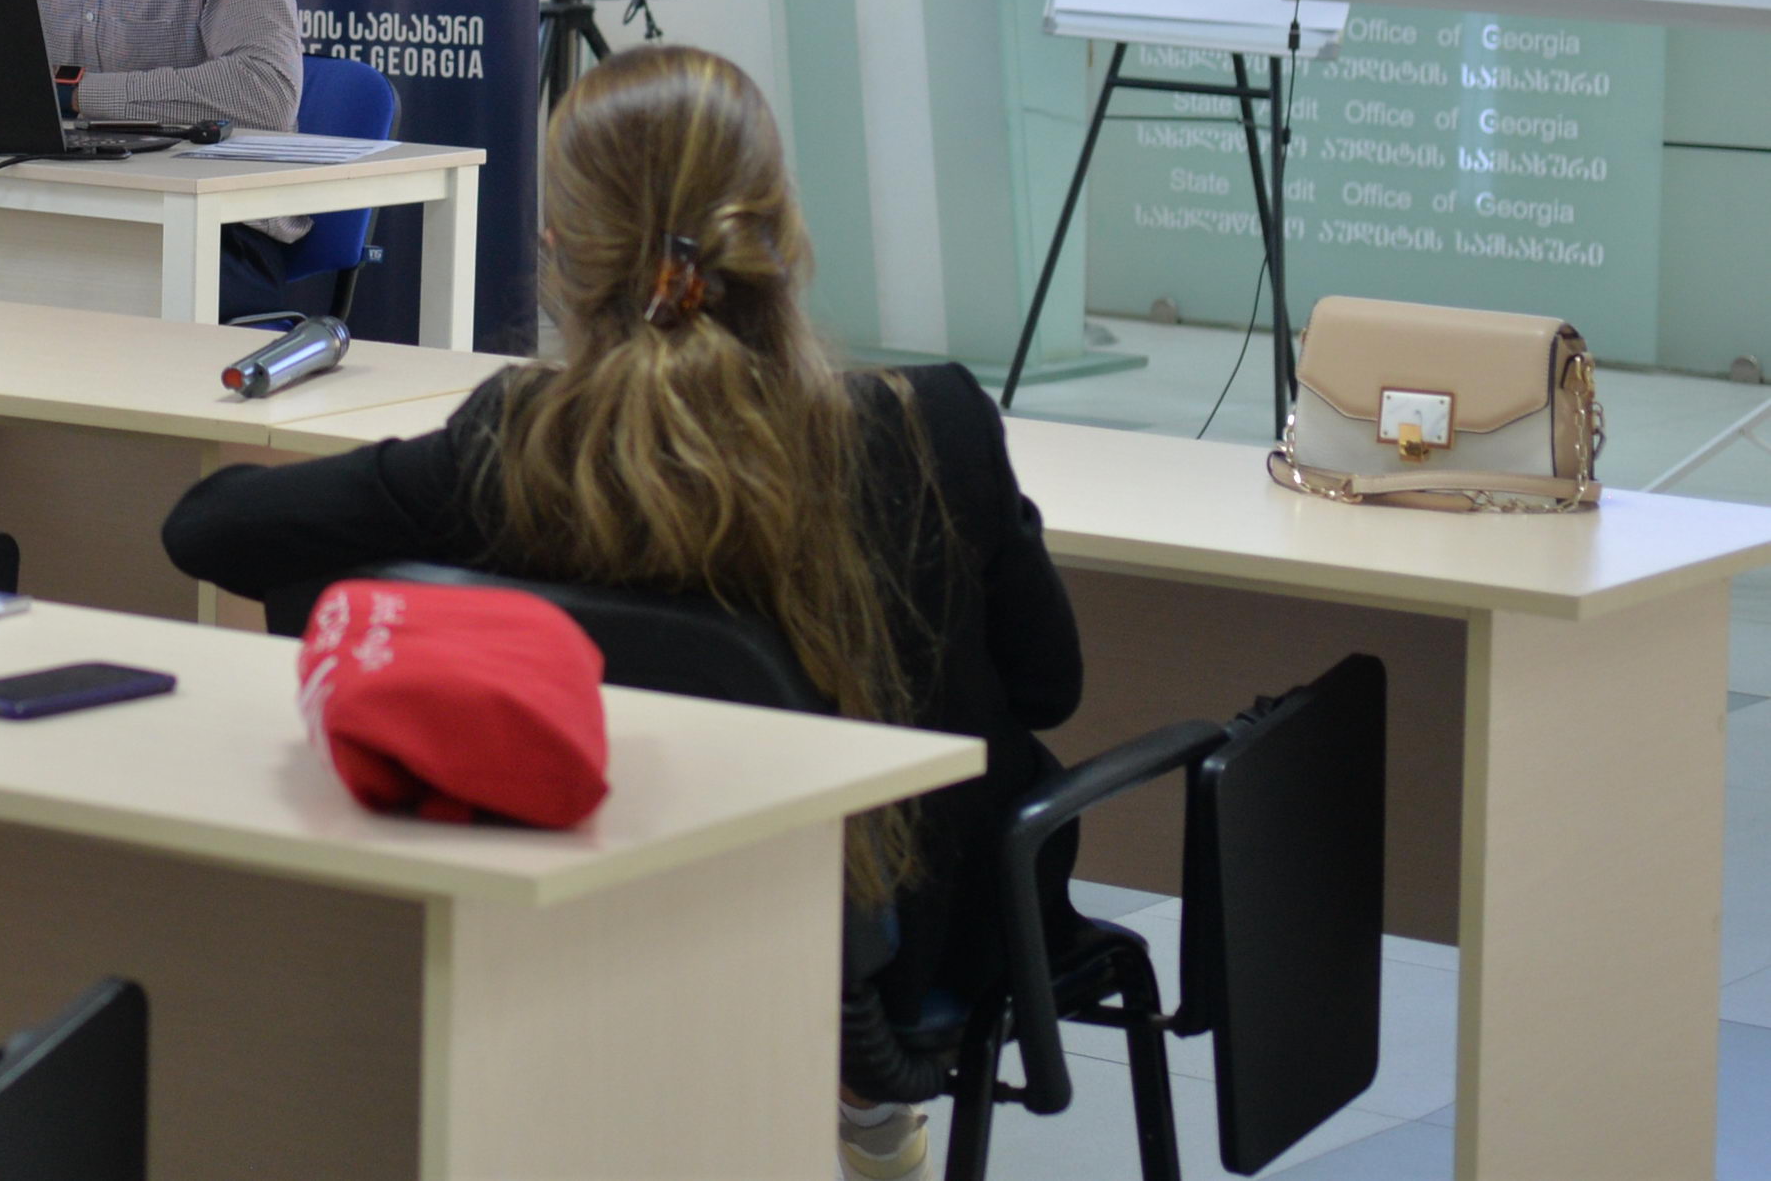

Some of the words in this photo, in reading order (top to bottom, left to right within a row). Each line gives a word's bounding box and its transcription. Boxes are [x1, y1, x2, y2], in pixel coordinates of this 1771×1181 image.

[1347, 18, 1418, 45] Office
[1437, 24, 1462, 48] of
[1481, 23, 1581, 59] Georgia
[369, 45, 485, 79] GEORGIA
[1172, 93, 1233, 116] State
[1343, 99, 1415, 127] Office
[1434, 107, 1460, 130] of
[1478, 108, 1580, 143] Georgia
[1170, 168, 1231, 196] State
[1341, 181, 1413, 210] Office
[1431, 189, 1458, 213] of
[1474, 191, 1576, 227] Georgia
